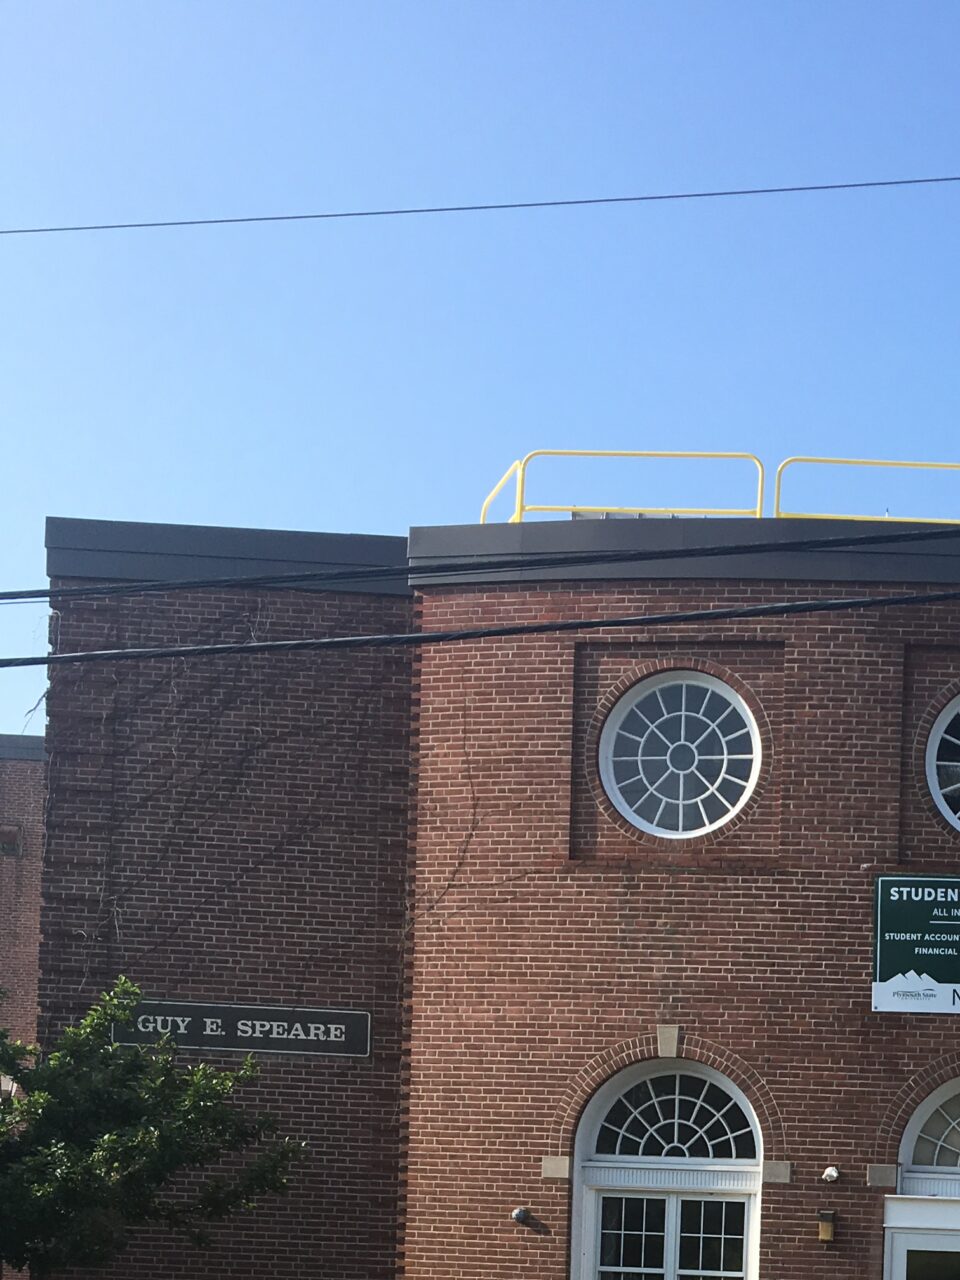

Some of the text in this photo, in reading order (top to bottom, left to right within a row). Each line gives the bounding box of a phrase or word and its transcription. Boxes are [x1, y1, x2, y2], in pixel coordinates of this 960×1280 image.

[932, 908, 948, 917] ALL
[951, 909, 960, 917] IN
[884, 933, 922, 941] STUDENT
[914, 947, 958, 956] FINANCIAL
[136, 1014, 346, 1041] GUY E. SPEARE
